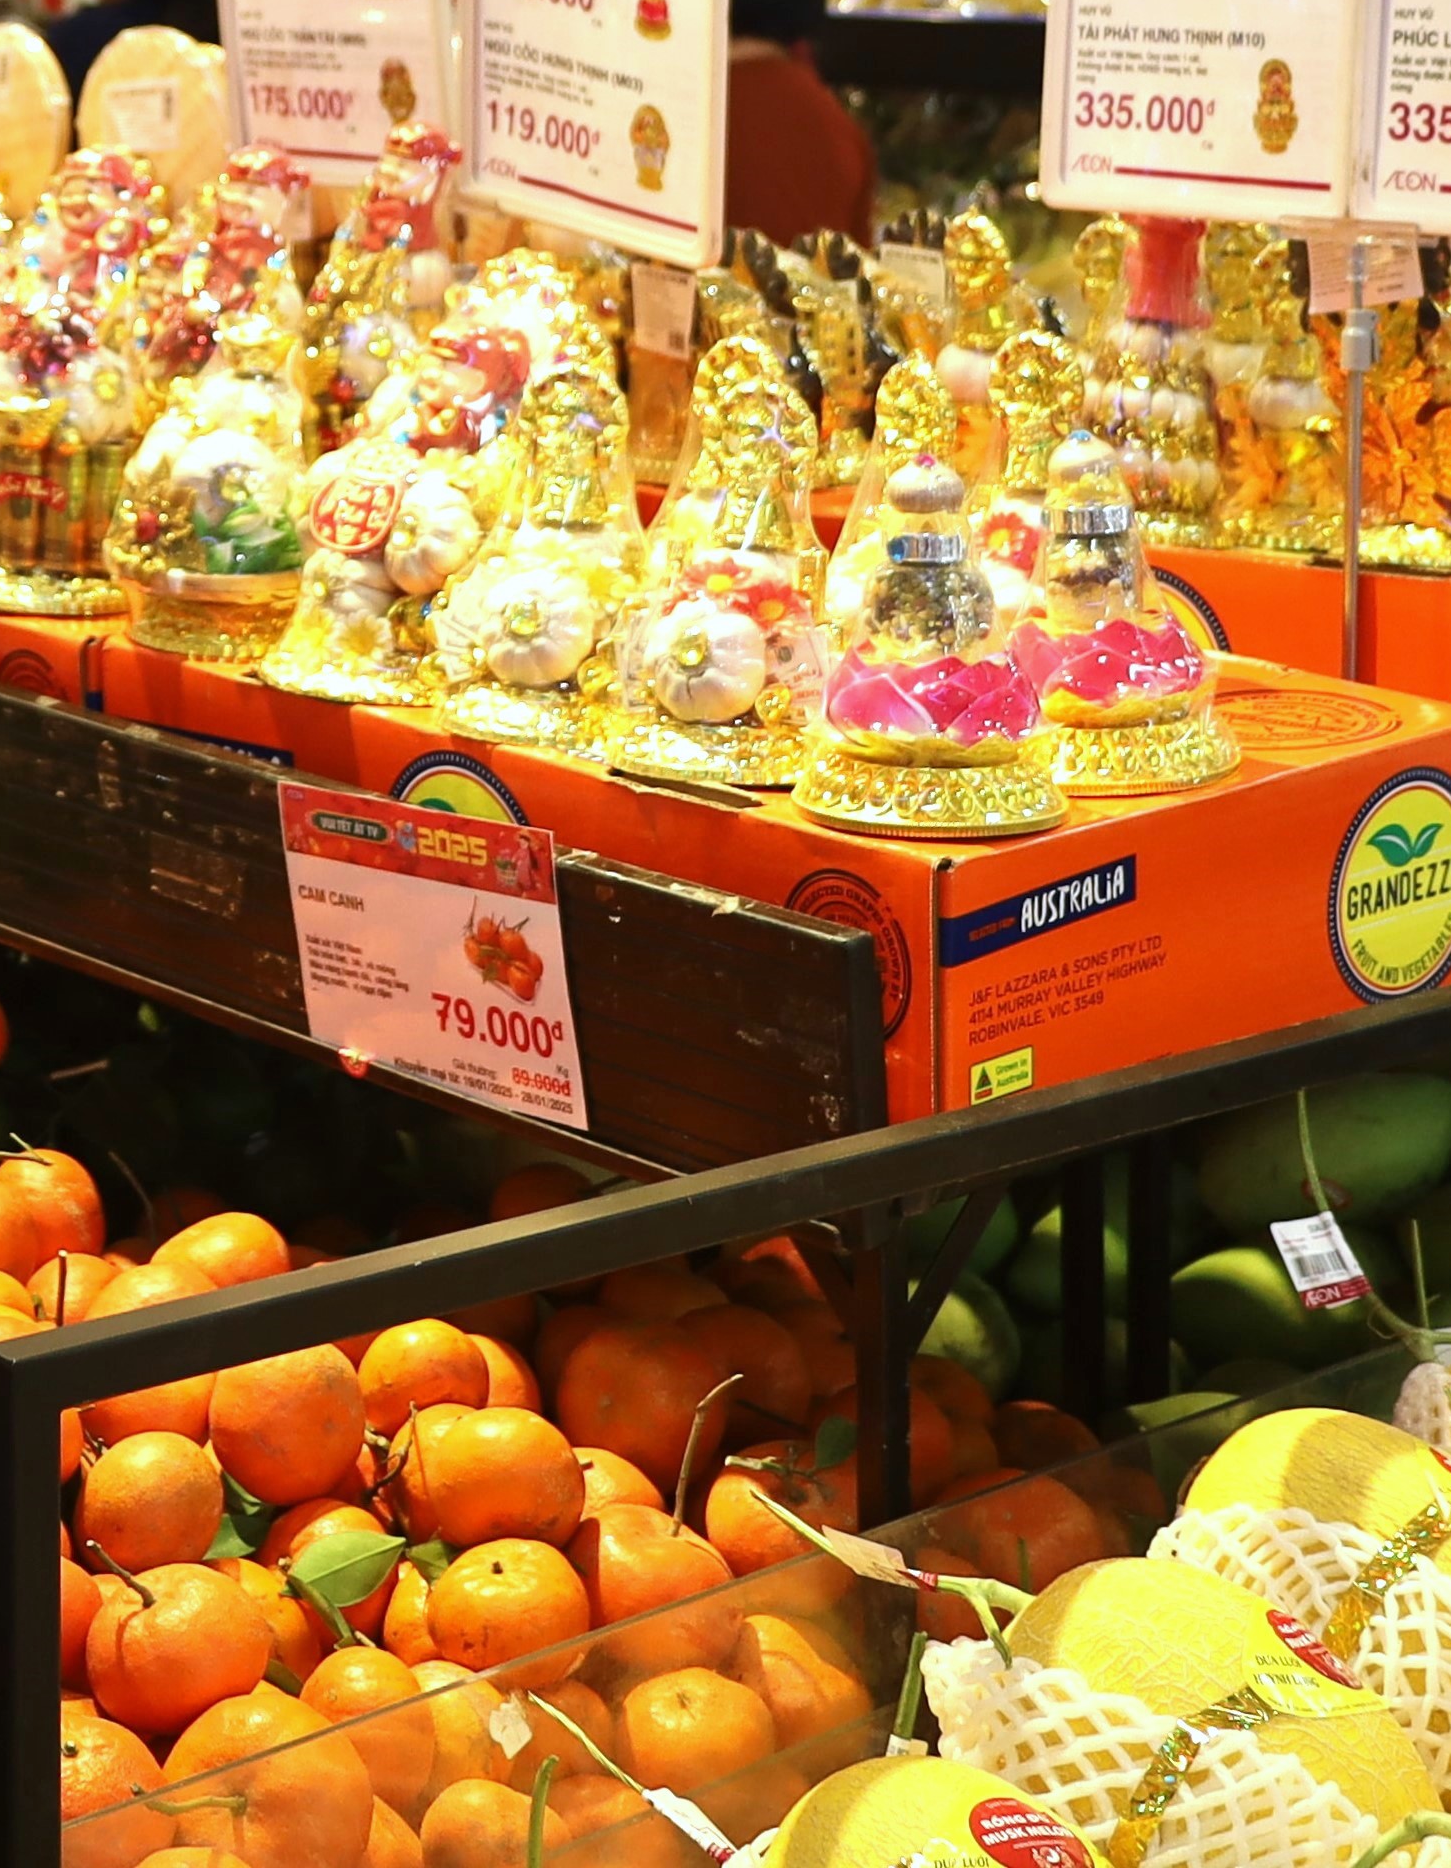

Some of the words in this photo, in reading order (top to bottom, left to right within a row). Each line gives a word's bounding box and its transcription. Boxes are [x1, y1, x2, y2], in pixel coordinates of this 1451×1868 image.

[1103, 24, 1138, 42] PHÁT
[1227, 32, 1266, 50] (M10)
[1393, 26, 1439, 47] PHÚC
[415, 826, 488, 867] 2025
[298, 884, 327, 904] CAM
[329, 890, 365, 912] CANH
[969, 986, 992, 1008] J&F
[997, 967, 1057, 998] LAZZARA
[1061, 962, 1070, 977] &
[1073, 951, 1108, 976] SONS
[1111, 944, 1137, 964] PTY
[1138, 936, 1162, 954] LTD
[1352, 939, 1378, 976] FRUIT
[1378, 966, 1399, 984] AND
[997, 987, 1052, 1015] MURRAY
[1055, 973, 1104, 998] VALLEY
[1107, 953, 1167, 983] HIGHWAY
[1049, 1001, 1070, 1019] VIC
[1073, 991, 1104, 1013] 3549
[982, 1829, 1029, 1846] MUSK
